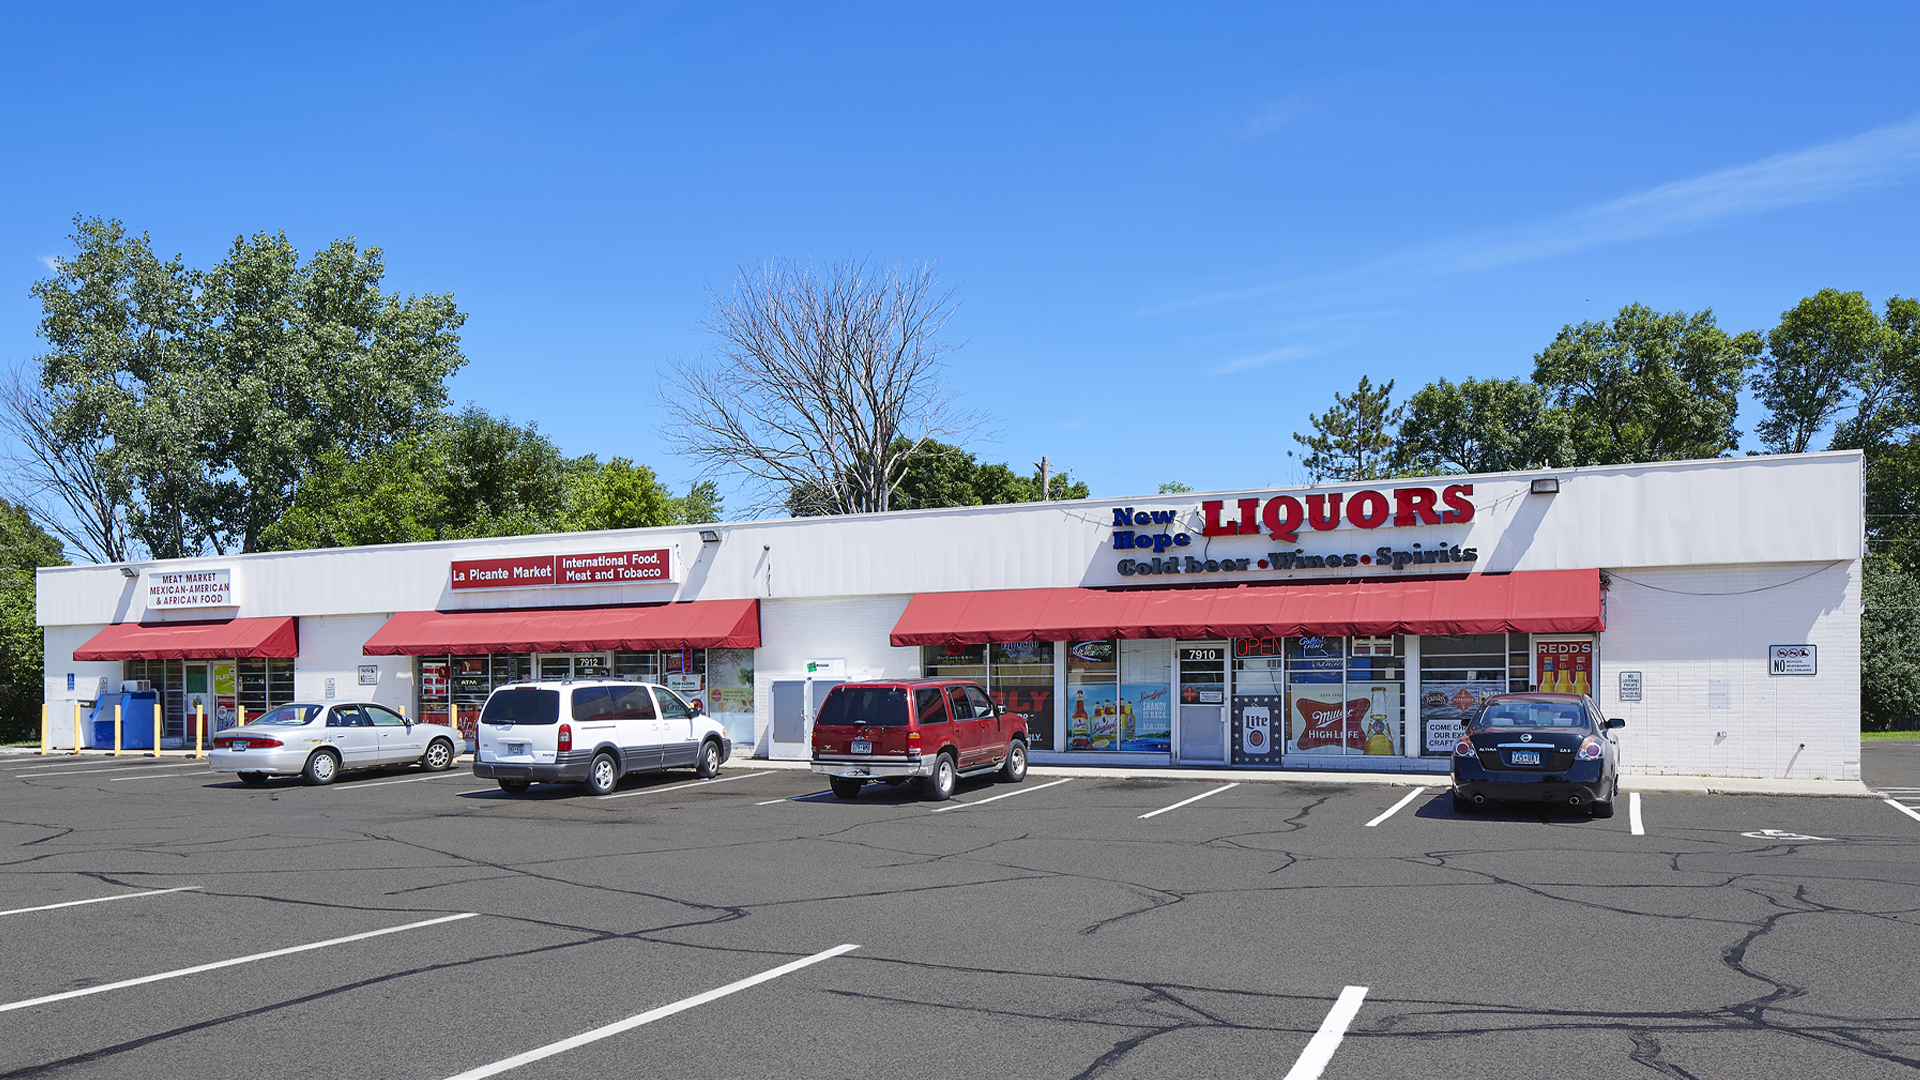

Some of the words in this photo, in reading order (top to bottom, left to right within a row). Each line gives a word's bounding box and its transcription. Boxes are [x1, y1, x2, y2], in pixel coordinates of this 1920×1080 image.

[1112, 507, 1177, 526] New
[1202, 484, 1475, 543] LIQUORS
[1113, 530, 1191, 553] Hope
[562, 555, 628, 569] International
[1117, 556, 1180, 576] Cold
[1184, 556, 1250, 574] beer
[1267, 548, 1358, 570] Wines
[1376, 542, 1478, 570] Spirits
[162, 575, 182, 584] MEAT
[186, 572, 216, 582] MARKET
[453, 570, 465, 581] La
[470, 568, 509, 580] Picante
[513, 565, 551, 578] Market
[566, 569, 592, 582] Meat
[595, 569, 614, 580] and
[617, 567, 661, 579] Tobacco
[150, 583, 230, 595] MEXICAN-AMERICAN
[156, 597, 162, 605] &
[164, 596, 197, 605] AFRICAN
[200, 594, 222, 604] FOOD
[1236, 637, 1282, 656] OPEN
[1538, 644, 1591, 654] REDD'S
[1189, 650, 1216, 660] 7910
[580, 658, 598, 666] 7912
[1774, 660, 1785, 672] NO
[990, 690, 1050, 712] PLY
[1143, 702, 1166, 710] SHANDY
[457, 717, 478, 729] Afri
[1245, 716, 1268, 729] Lite
[1312, 708, 1353, 725] Miller
[1308, 730, 1332, 738] HIGH
